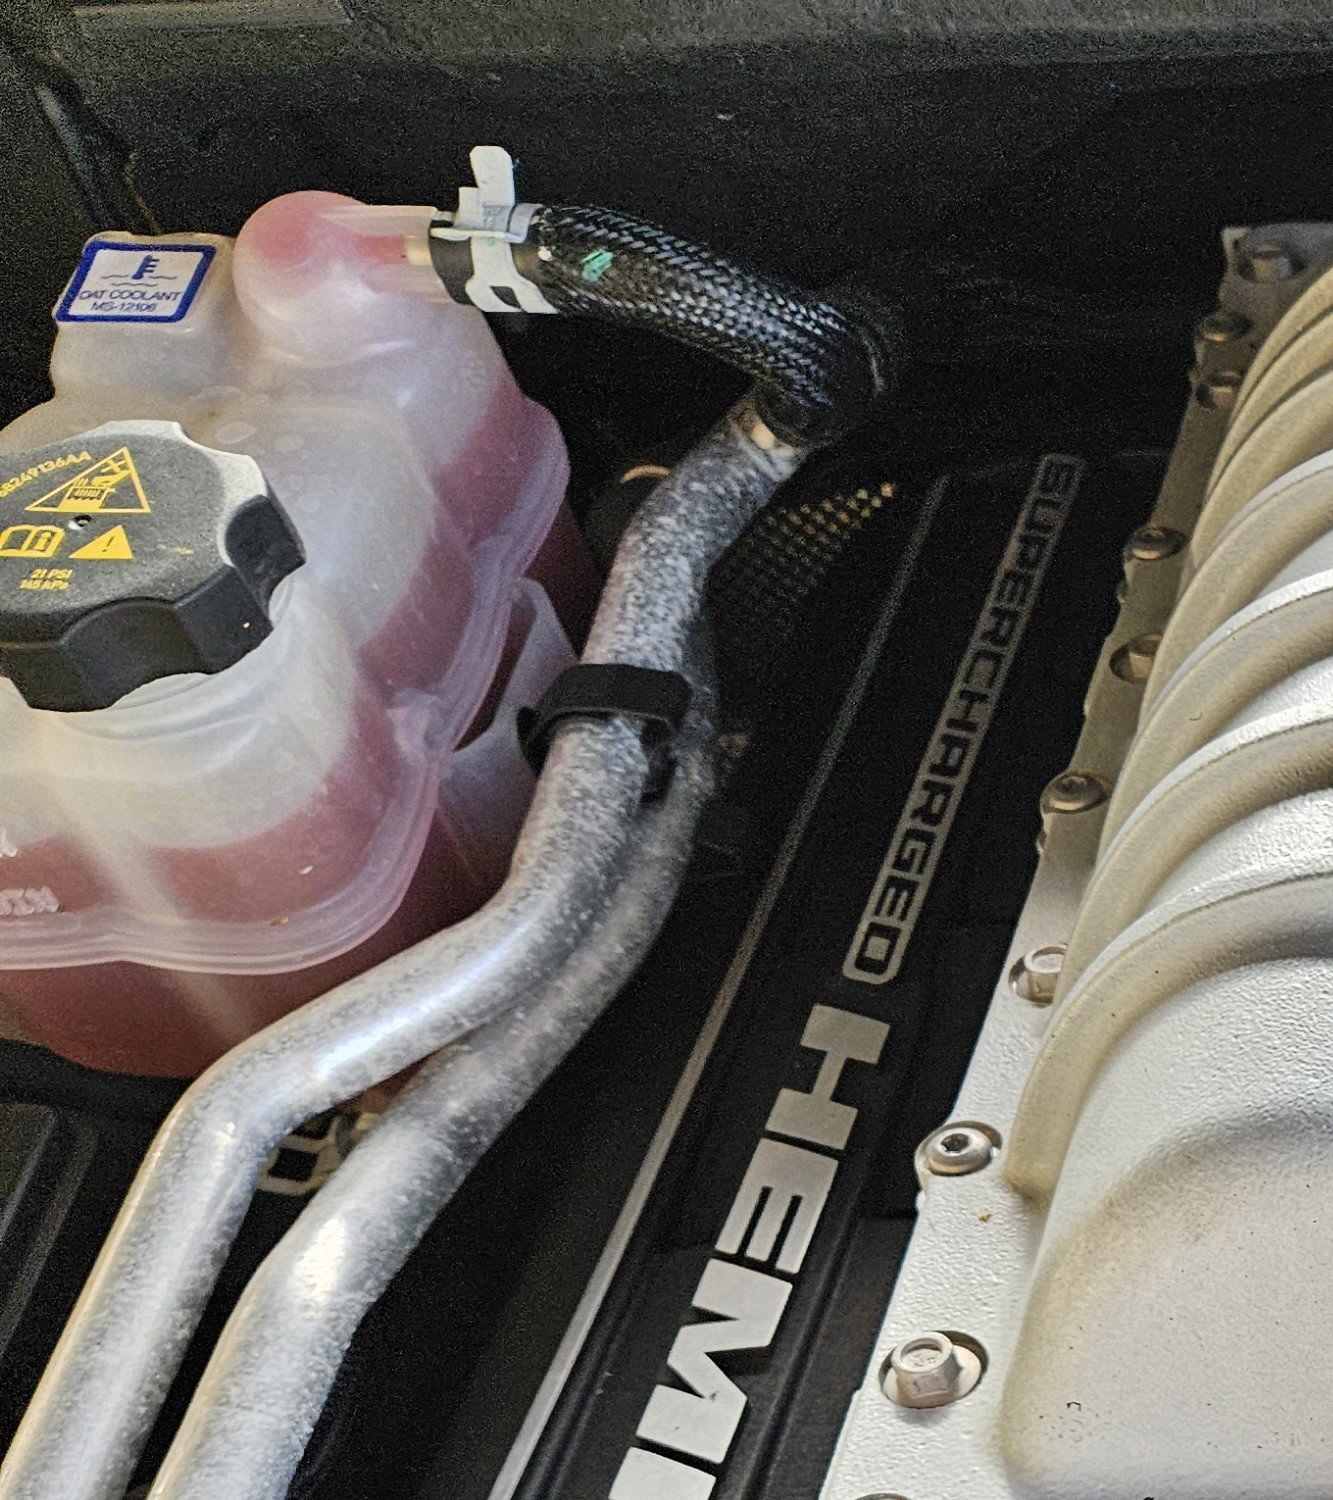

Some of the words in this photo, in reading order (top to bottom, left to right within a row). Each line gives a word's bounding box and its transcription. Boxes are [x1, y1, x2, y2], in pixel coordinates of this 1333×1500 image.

[78, 289, 108, 301] OAT
[109, 289, 184, 301] COOLANT
[850, 460, 1080, 978] SUPERCHARGED
